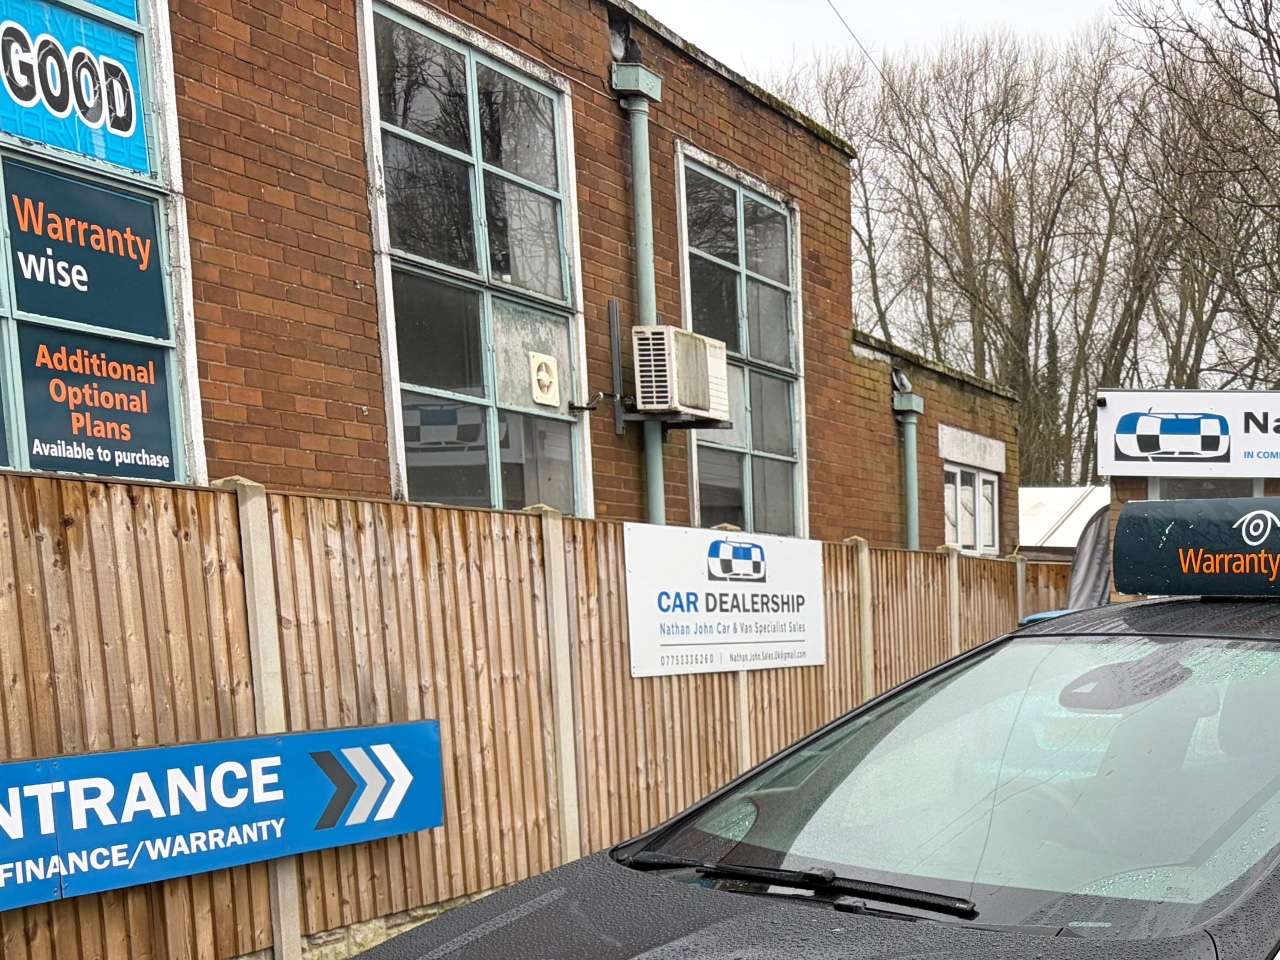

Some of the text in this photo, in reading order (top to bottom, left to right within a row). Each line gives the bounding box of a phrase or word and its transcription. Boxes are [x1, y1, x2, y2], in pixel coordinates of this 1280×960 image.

[0, 22, 136, 137] GOOD
[12, 194, 151, 271] Warranty
[17, 247, 89, 292] wise
[35, 344, 155, 385] Additional
[49, 378, 148, 413] Optional
[71, 412, 132, 441] Plans
[32, 438, 170, 467] Available to purchase
[1243, 451, 1254, 459] IN
[657, 591, 806, 614] CAR DEALERSHIP
[660, 621, 806, 636] Nathan John Car & Van Specialist Sales
[0, 817, 286, 888] FINANCE/WARRANTY
